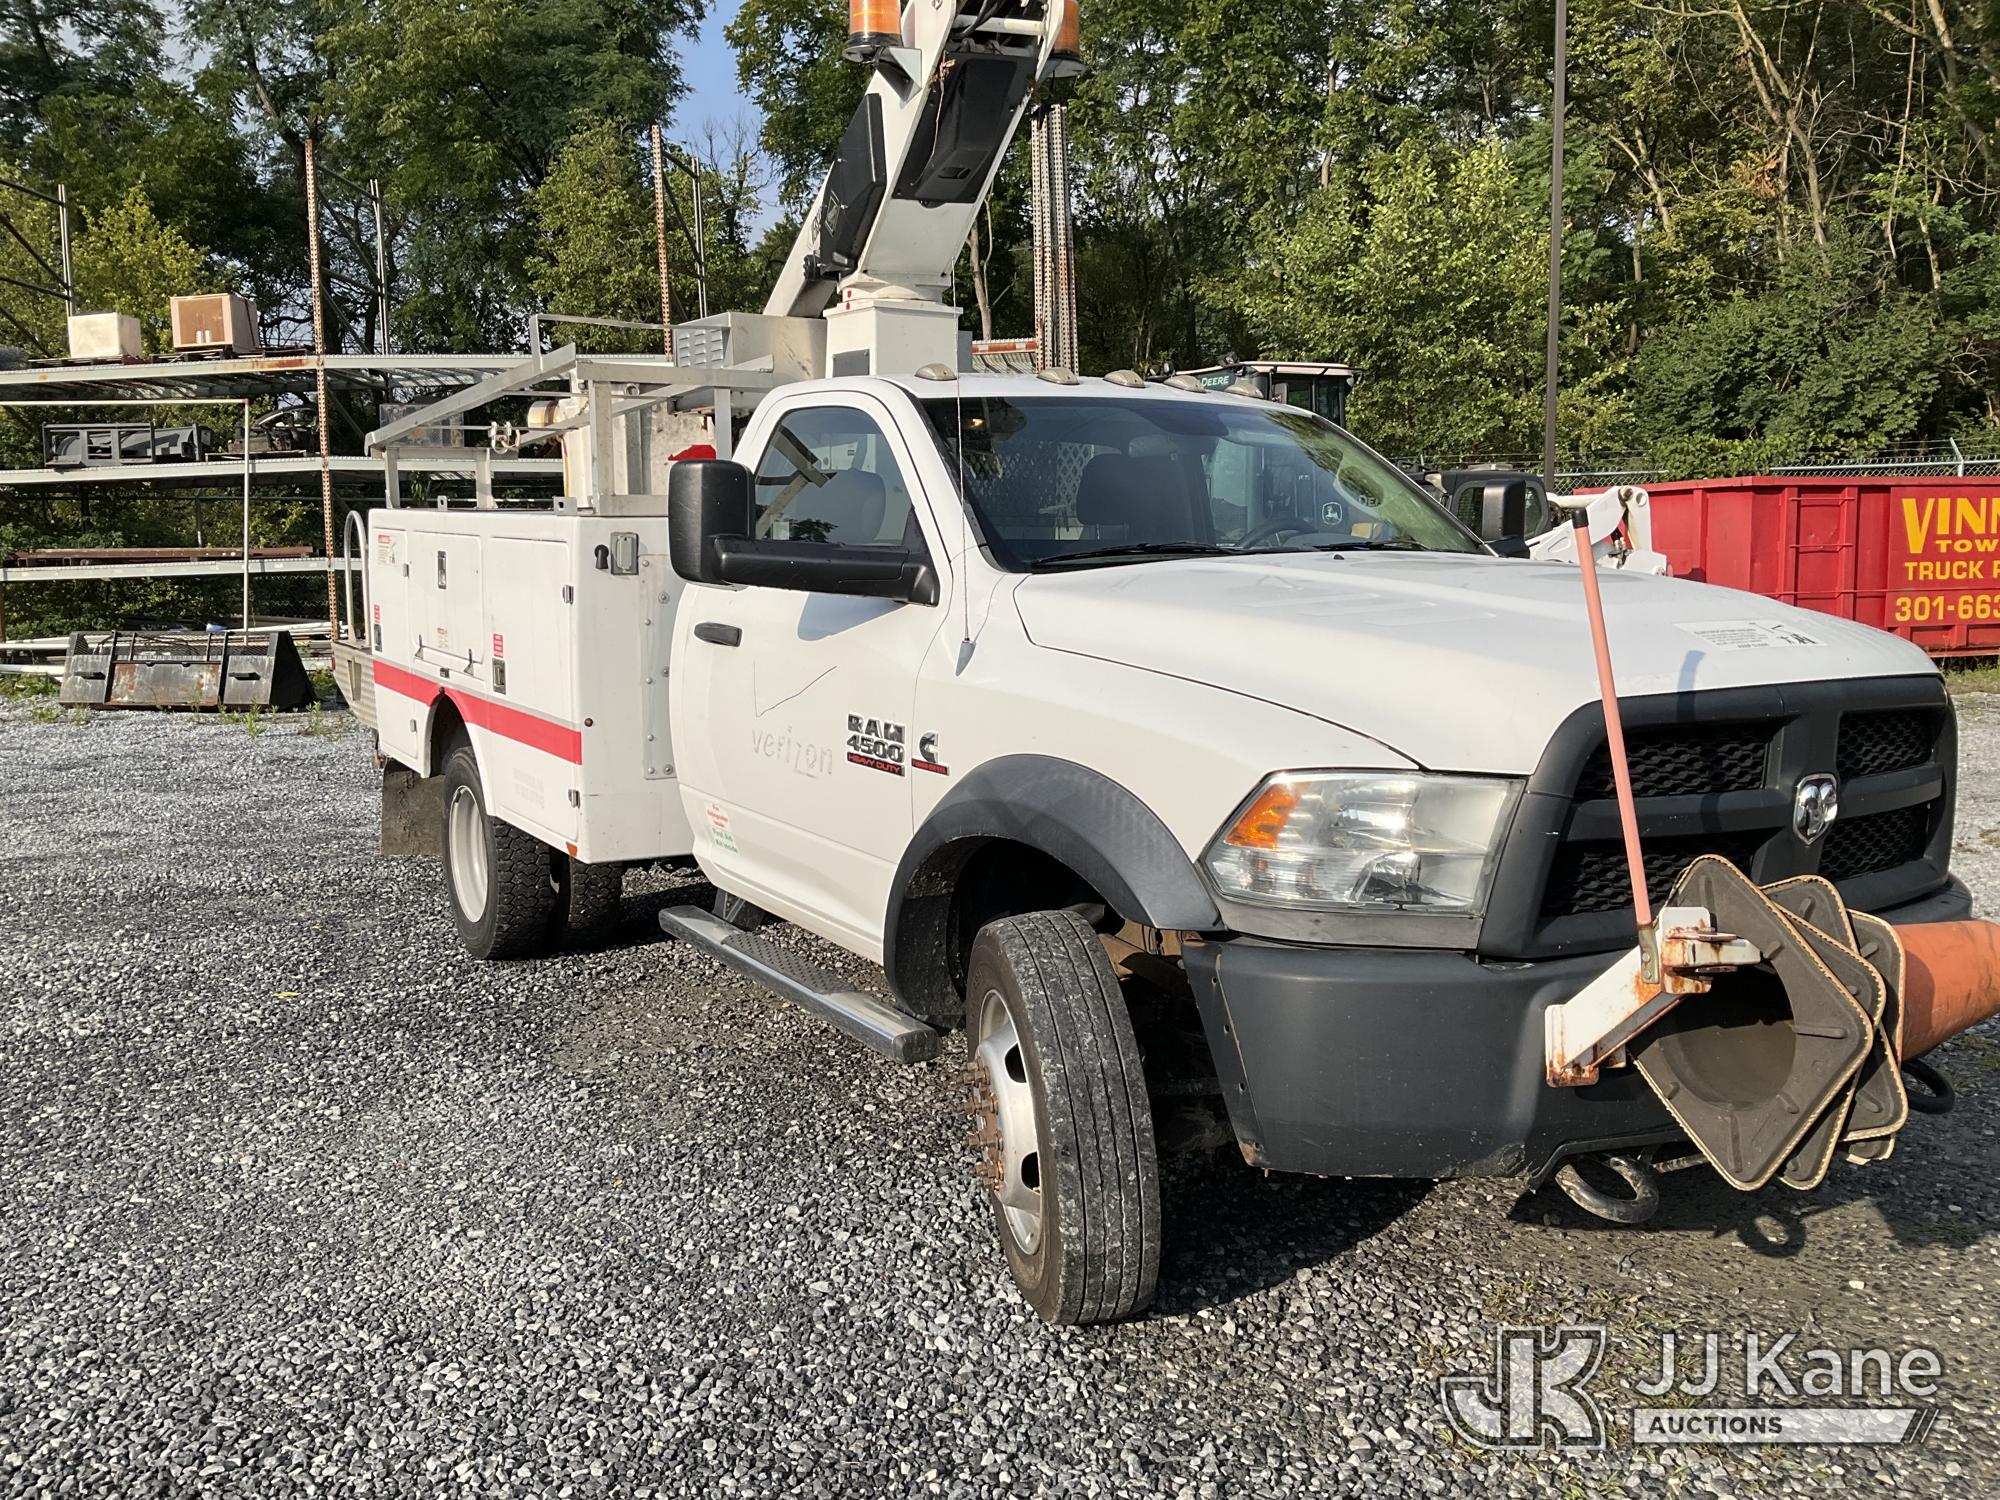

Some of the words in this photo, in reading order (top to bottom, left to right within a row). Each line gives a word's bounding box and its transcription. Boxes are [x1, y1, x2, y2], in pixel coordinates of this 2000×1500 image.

[1201, 375, 1230, 387] DEERE
[1905, 560, 1984, 581] TRUCK
[847, 713, 905, 744] RAM
[847, 733, 905, 763] 4500
[848, 754, 875, 768] HEAVY
[875, 761, 901, 774] DUTY
